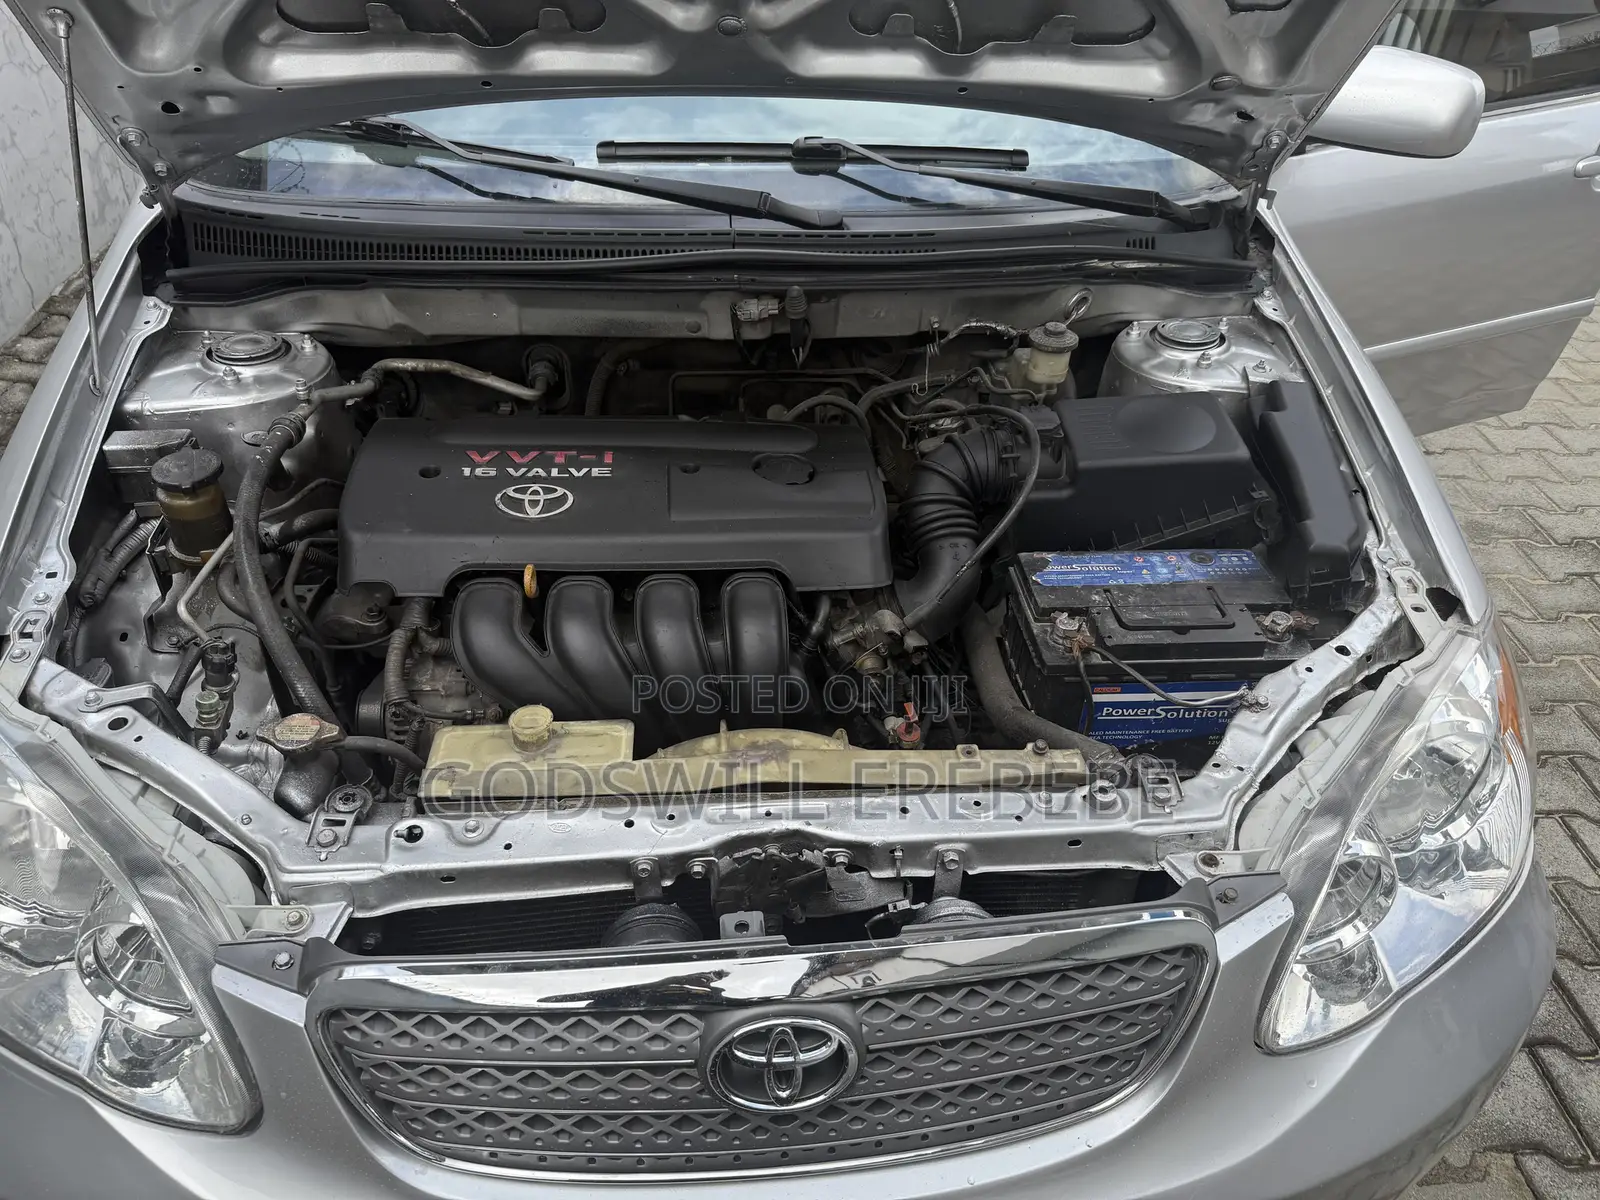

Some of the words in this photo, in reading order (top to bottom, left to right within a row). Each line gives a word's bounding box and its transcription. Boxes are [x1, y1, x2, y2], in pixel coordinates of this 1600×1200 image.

[461, 467, 497, 477] 16
[505, 467, 612, 477] VALVE
[1043, 562, 1122, 572] owerSolution
